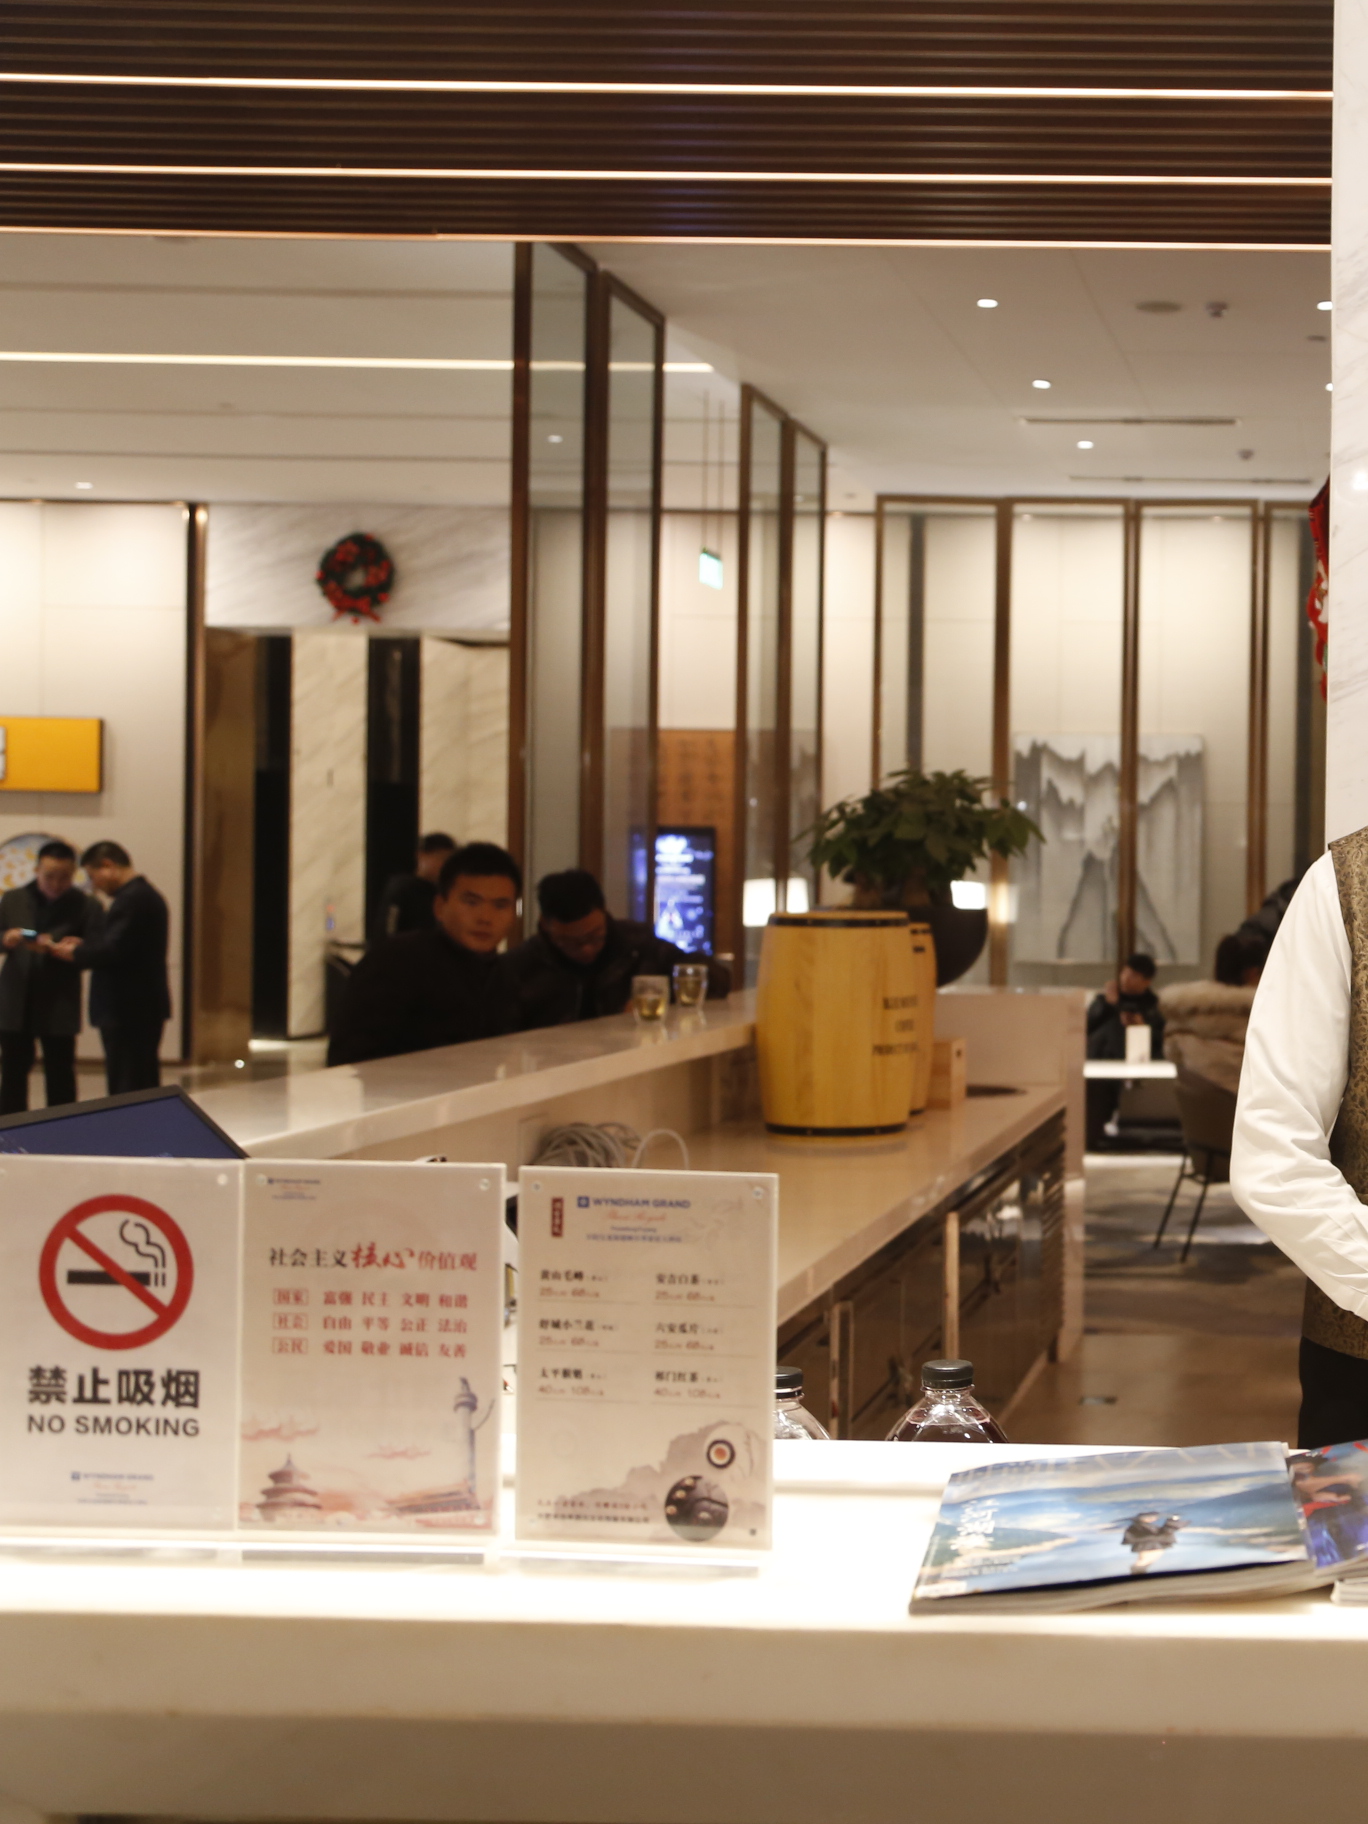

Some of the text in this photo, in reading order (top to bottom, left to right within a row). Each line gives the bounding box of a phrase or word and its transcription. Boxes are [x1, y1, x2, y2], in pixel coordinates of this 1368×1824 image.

[592, 1197, 691, 1209] WYNDHAM GRAND
[269, 1241, 478, 1272] 社会主义核心价值观
[277, 1290, 468, 1309] 国家 富强 民主 文明 和谐
[277, 1314, 467, 1333] 社会 自由 平等 公正 法治
[323, 1340, 352, 1356] 爱国
[361, 1341, 390, 1356] 敬业
[399, 1341, 429, 1357] 诚信
[438, 1342, 467, 1358] 友善
[28, 1364, 200, 1409] 禁止吸烟
[27, 1414, 200, 1437] NO SMOKING
